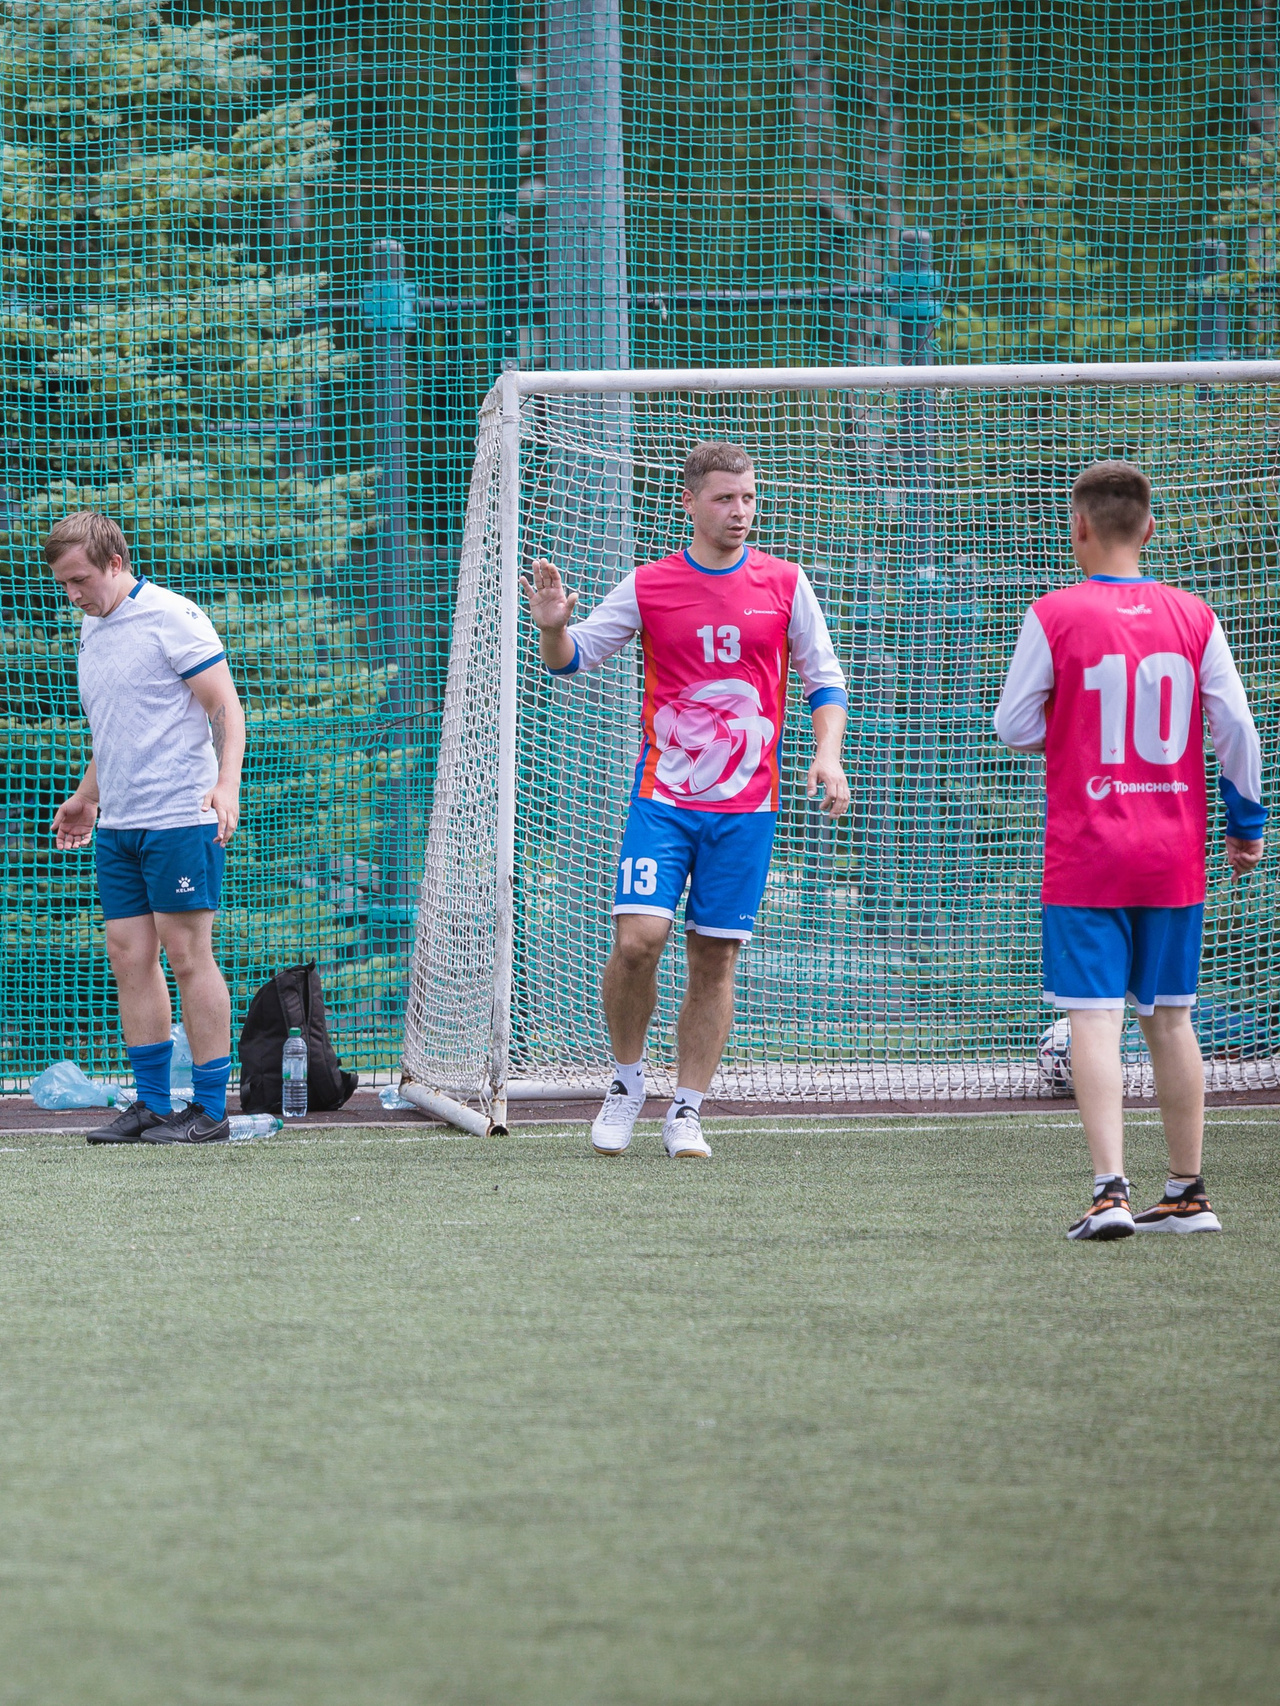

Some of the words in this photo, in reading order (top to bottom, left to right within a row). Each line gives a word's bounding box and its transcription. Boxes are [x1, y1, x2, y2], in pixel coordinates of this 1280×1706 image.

[697, 625, 741, 663] 13
[1084, 652, 1195, 765] 10
[1113, 780, 1189, 795] Транснефть
[620, 857, 657, 896] 13
